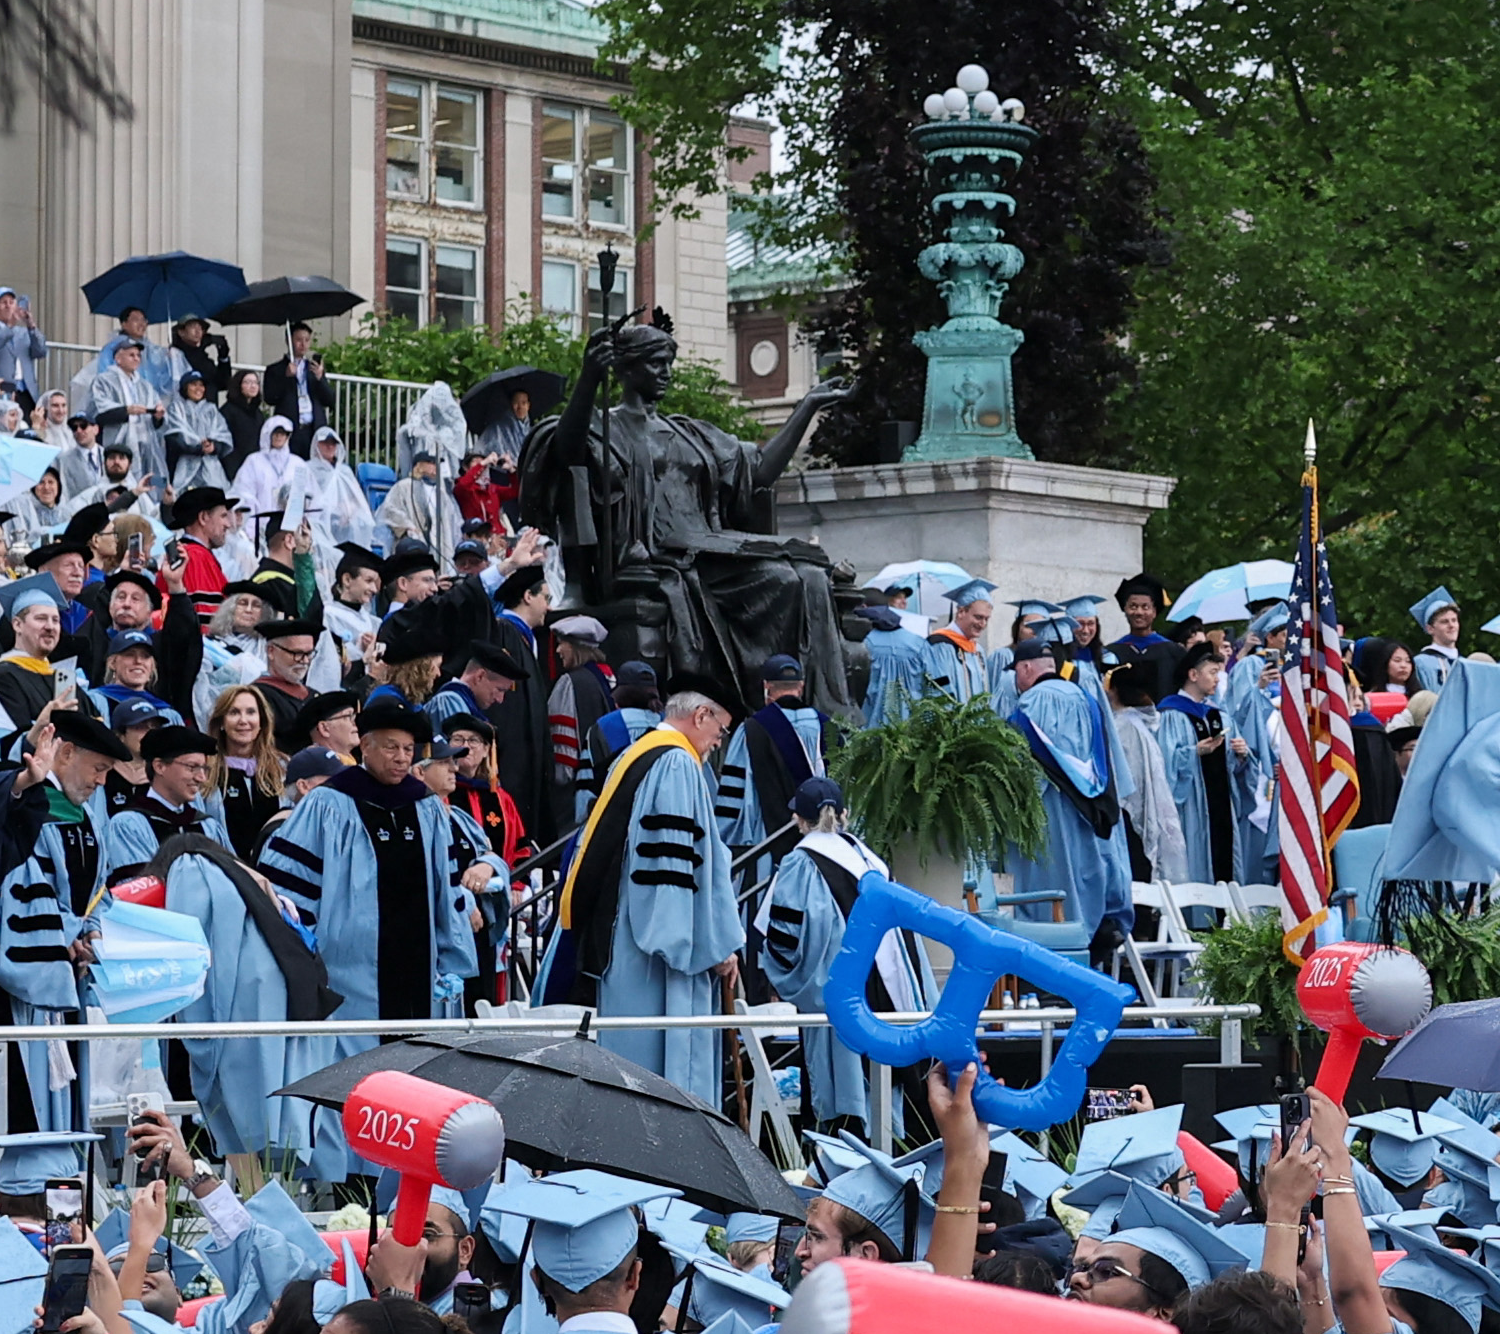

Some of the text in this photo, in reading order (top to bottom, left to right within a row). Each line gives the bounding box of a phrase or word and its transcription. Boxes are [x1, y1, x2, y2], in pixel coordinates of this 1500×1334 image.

[127, 874, 159, 895] 202
[1303, 956, 1350, 988] 2025
[356, 1105, 421, 1152] 2025
